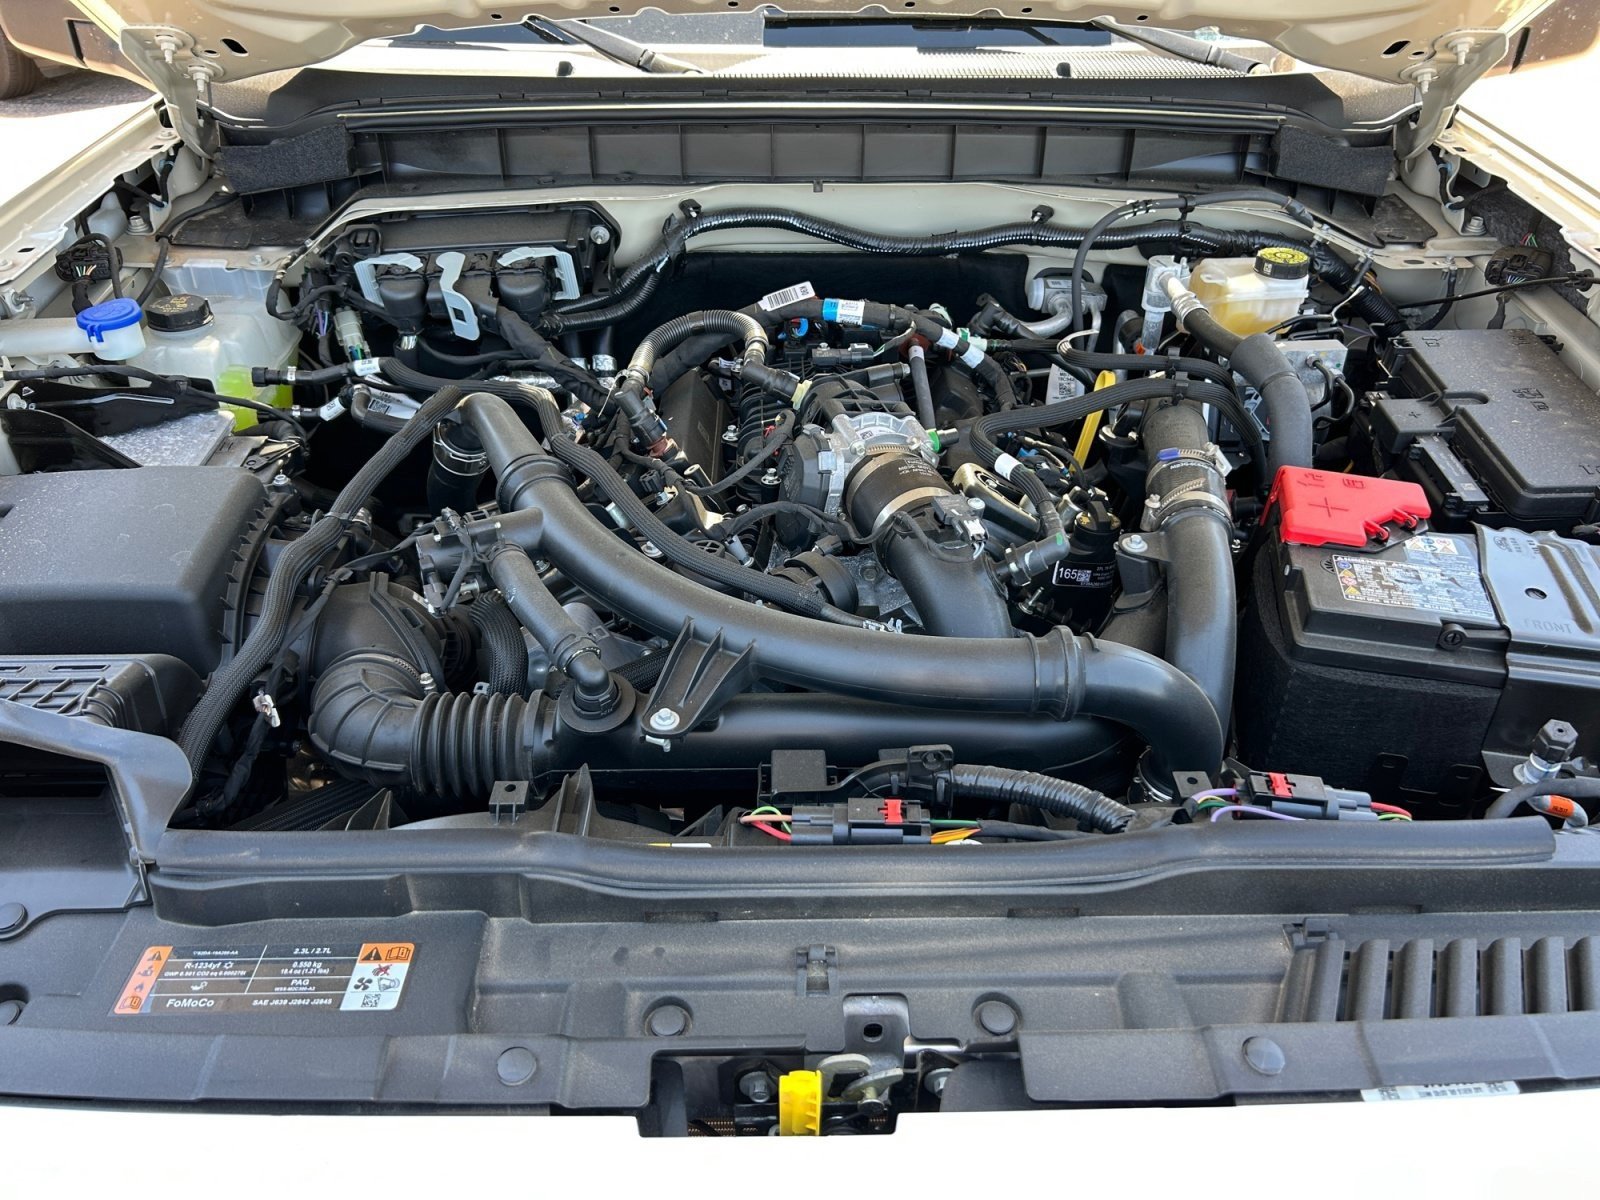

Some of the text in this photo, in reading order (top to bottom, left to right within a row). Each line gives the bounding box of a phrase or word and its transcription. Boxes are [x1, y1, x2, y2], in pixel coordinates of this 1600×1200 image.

[1059, 567, 1077, 579] 165
[1524, 618, 1572, 634] FRONT
[184, 961, 222, 970] R-1234yf
[312, 961, 323, 969] kg
[290, 978, 310, 986] PAG
[166, 998, 215, 1008] FoMoCo
